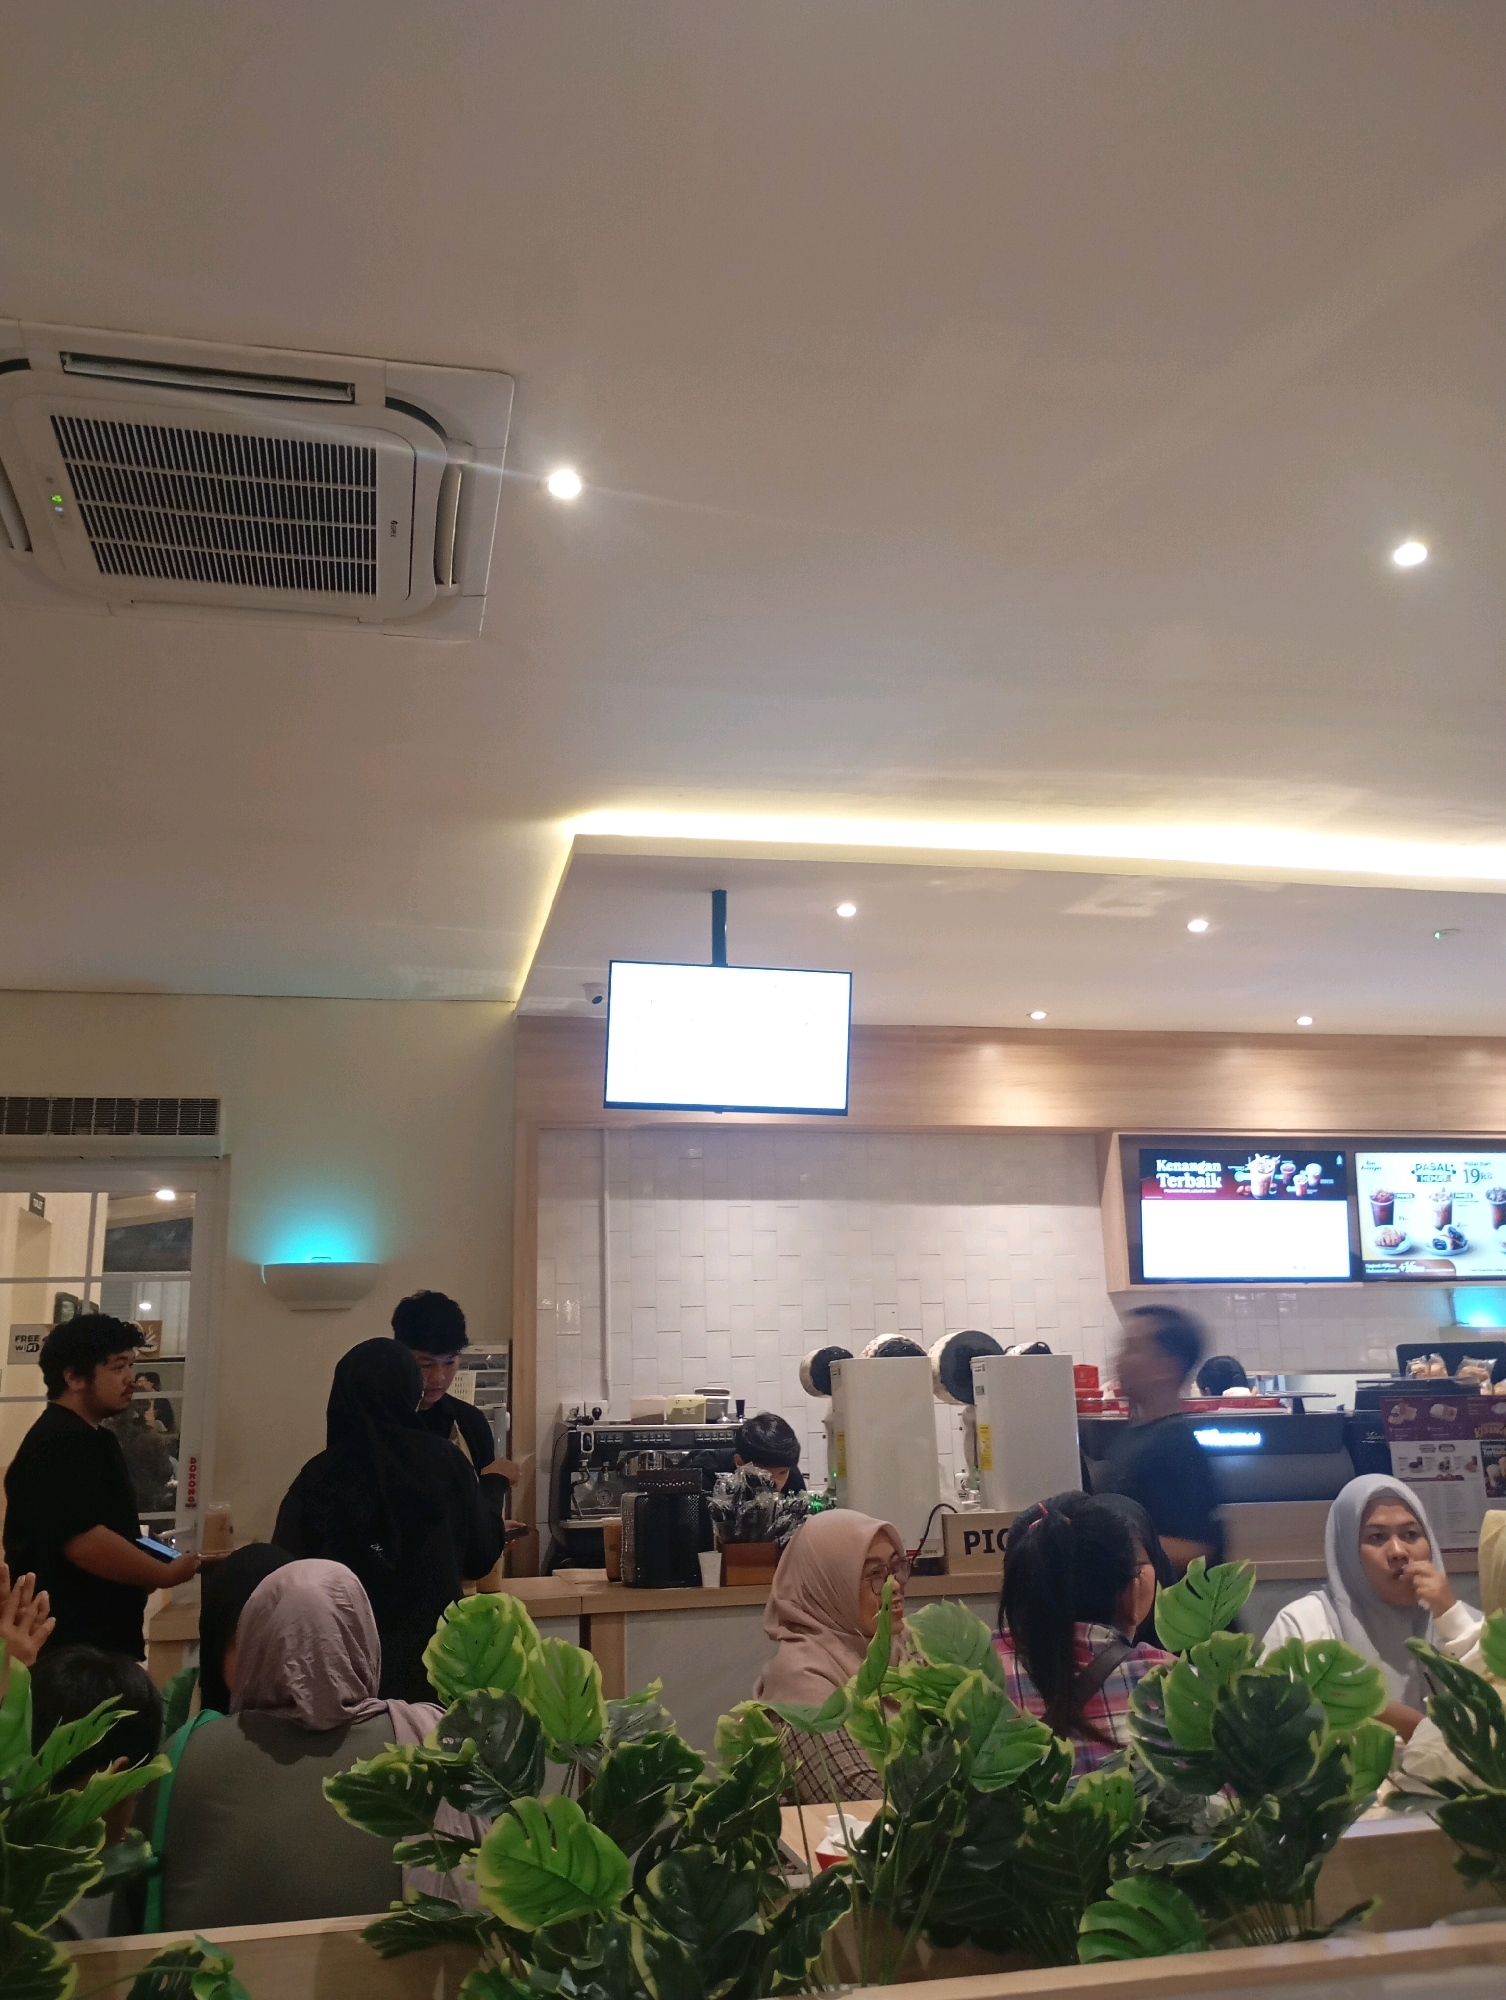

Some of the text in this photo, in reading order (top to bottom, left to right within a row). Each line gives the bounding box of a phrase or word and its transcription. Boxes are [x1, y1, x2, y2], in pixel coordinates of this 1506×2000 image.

[1156, 1159, 1222, 1175] Kenangan
[1415, 1163, 1451, 1172] PASAL
[1156, 1172, 1223, 1188] Terbaik
[14, 1334, 41, 1342] FREE
